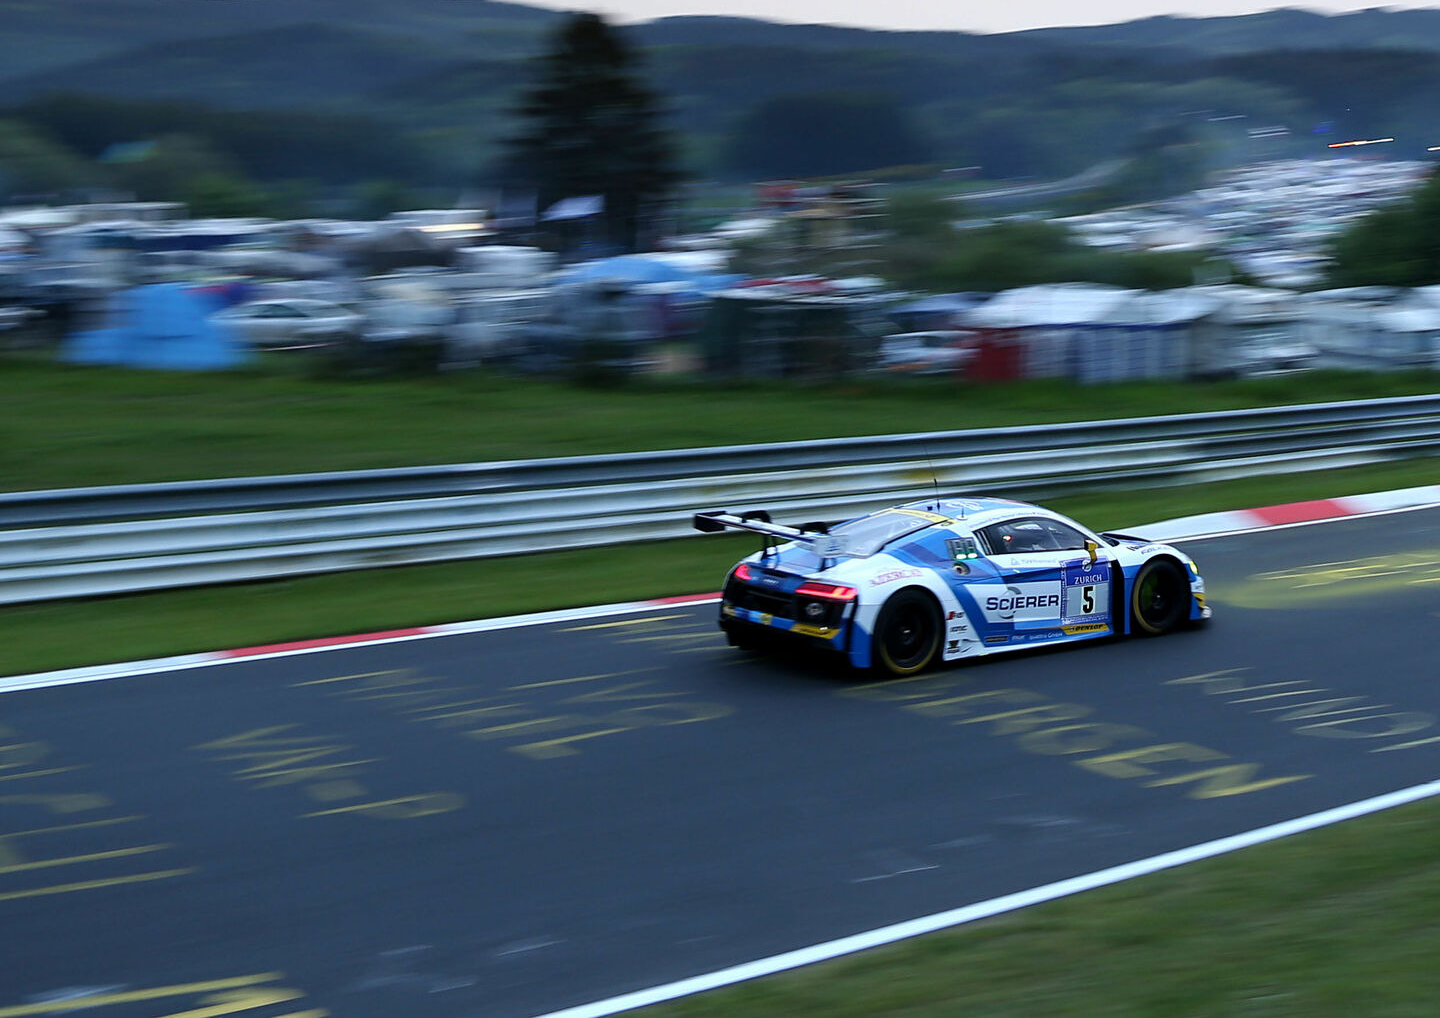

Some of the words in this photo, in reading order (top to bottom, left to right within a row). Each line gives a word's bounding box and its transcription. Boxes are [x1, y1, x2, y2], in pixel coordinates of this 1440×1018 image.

[1074, 574, 1102, 584] ZURICH
[1083, 586, 1094, 614] 5
[1075, 623, 1104, 631] DUNLOP
